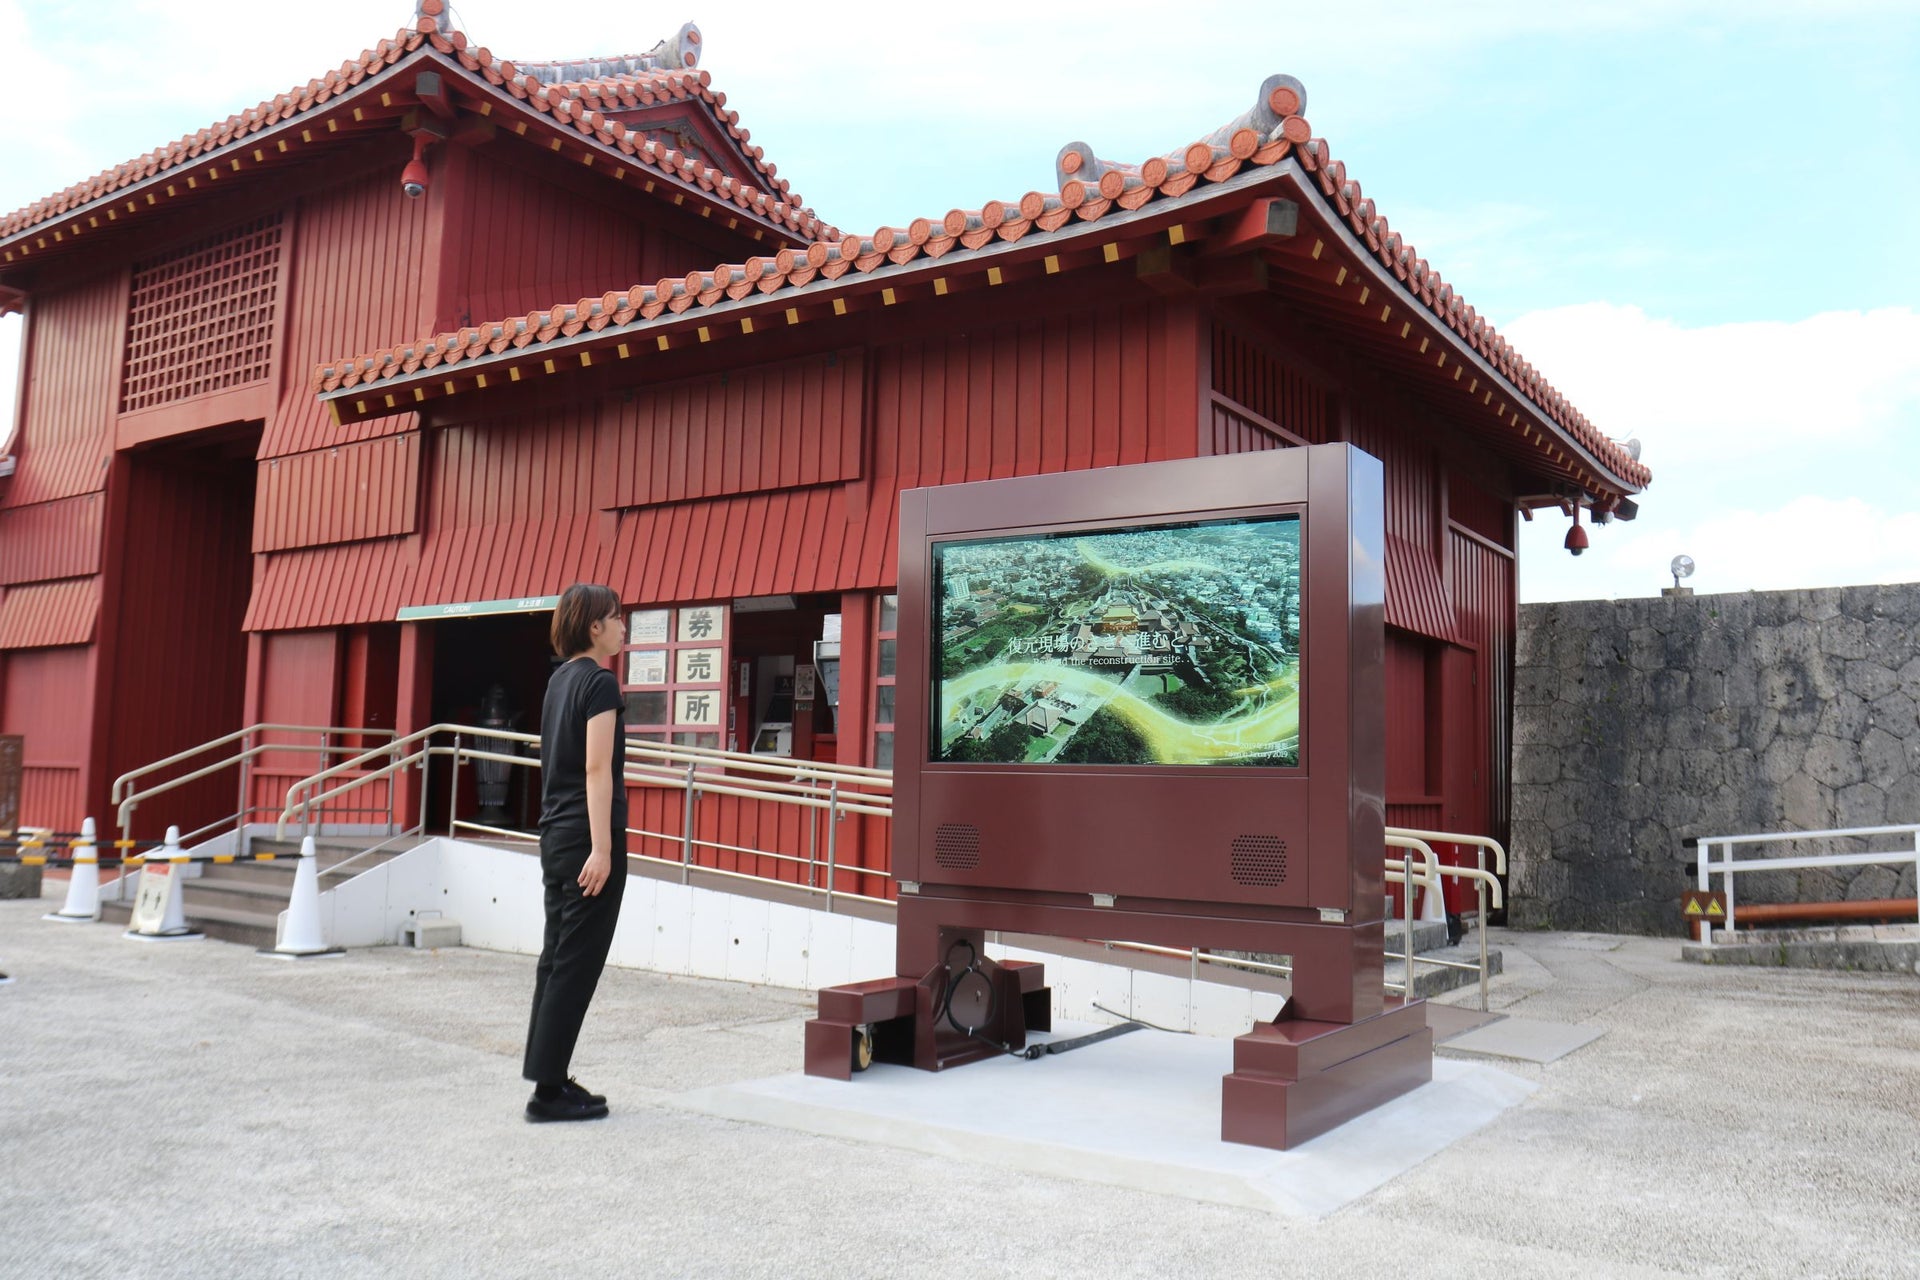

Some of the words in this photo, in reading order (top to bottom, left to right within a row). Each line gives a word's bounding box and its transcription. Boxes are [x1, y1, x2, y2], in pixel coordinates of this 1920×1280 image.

[685, 610, 713, 722] 券売所
[1033, 656, 1069, 667] Bed
[1071, 656, 1086, 666] the
[1089, 654, 1159, 666] reconstruction
[1272, 750, 1288, 758] 2019
